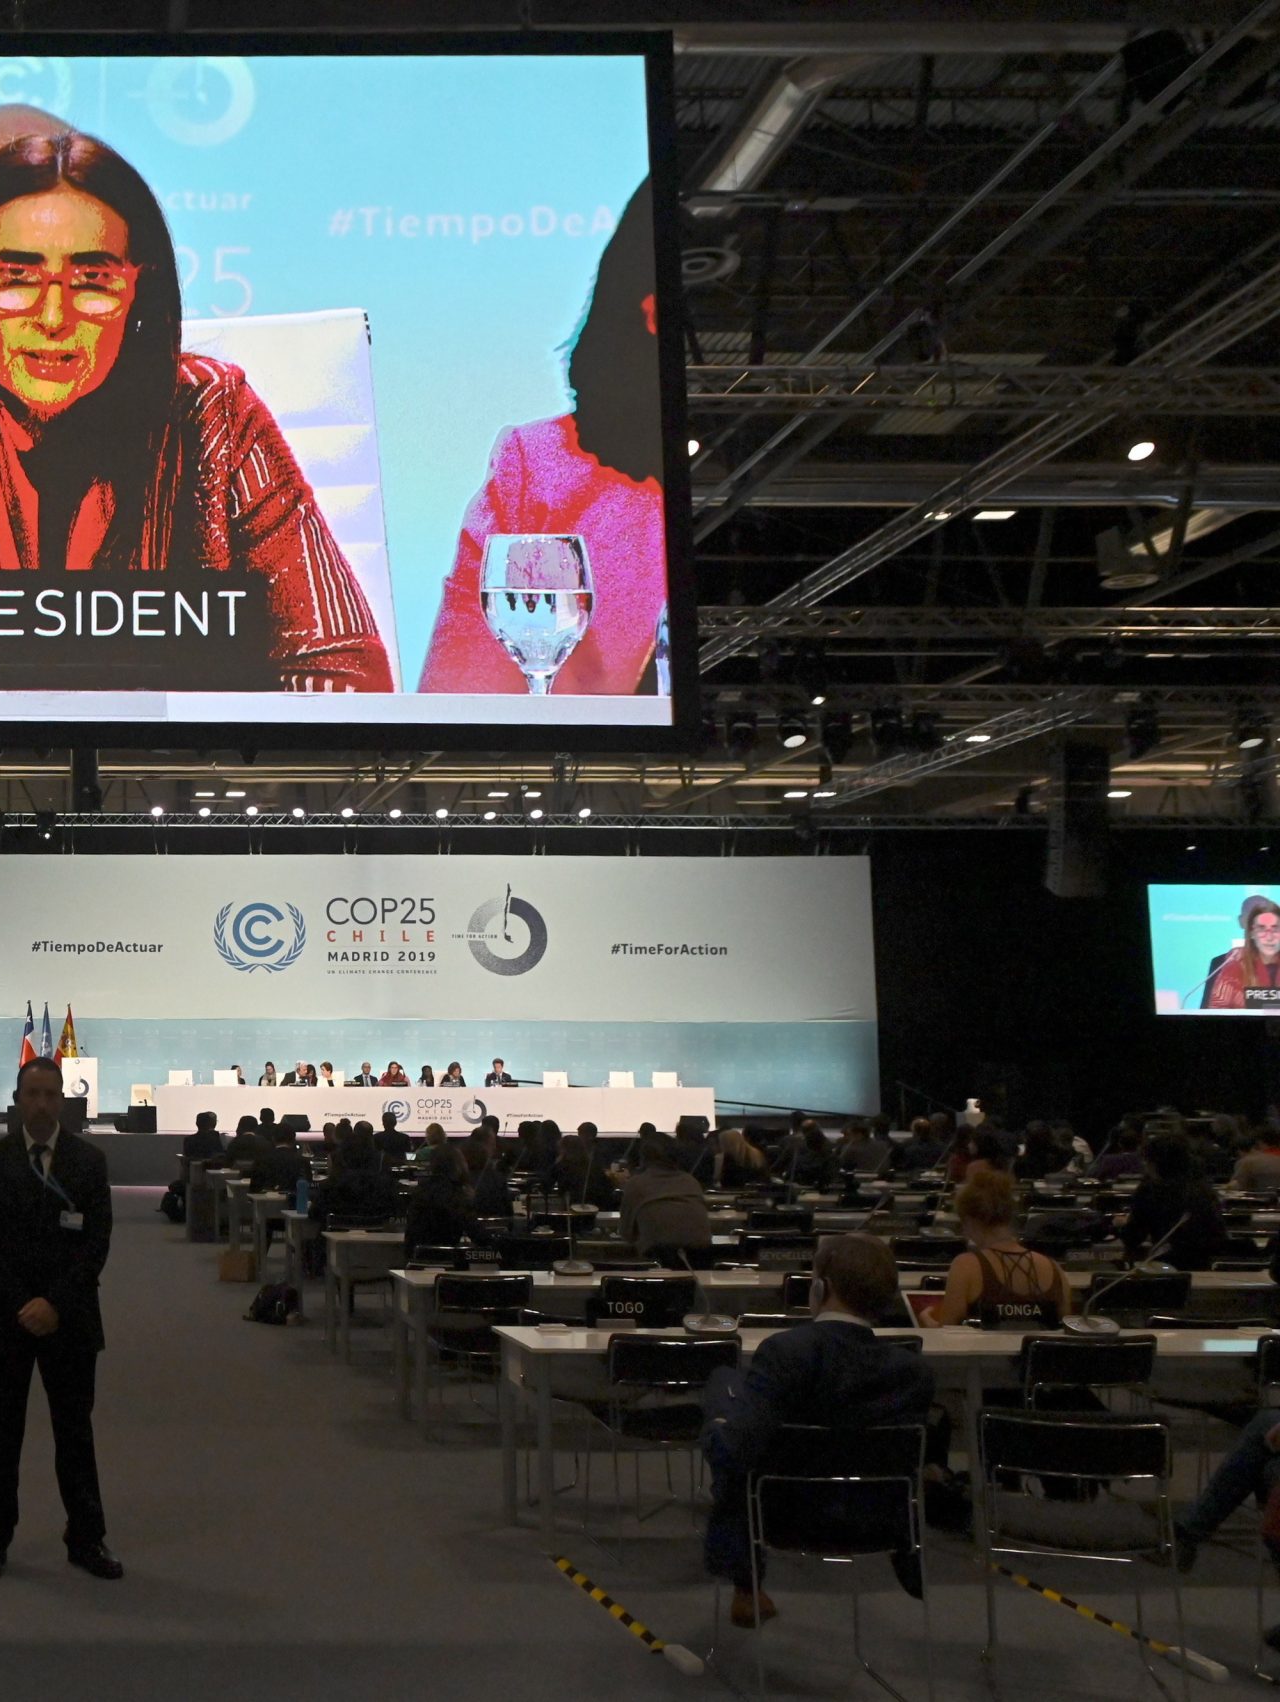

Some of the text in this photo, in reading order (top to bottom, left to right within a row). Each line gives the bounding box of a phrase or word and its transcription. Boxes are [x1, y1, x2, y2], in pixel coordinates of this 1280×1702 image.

[326, 897, 435, 925] COP25
[326, 930, 435, 942] CHILE
[31, 940, 163, 954] #TiempoDeActuar
[611, 943, 728, 955] #TimeForAction
[327, 951, 436, 961] MADRID 2019
[417, 1099, 453, 1109] COP25
[465, 1251, 502, 1260] SERBIA
[608, 1302, 644, 1313] TOGO
[996, 1304, 1042, 1316] TONGA
